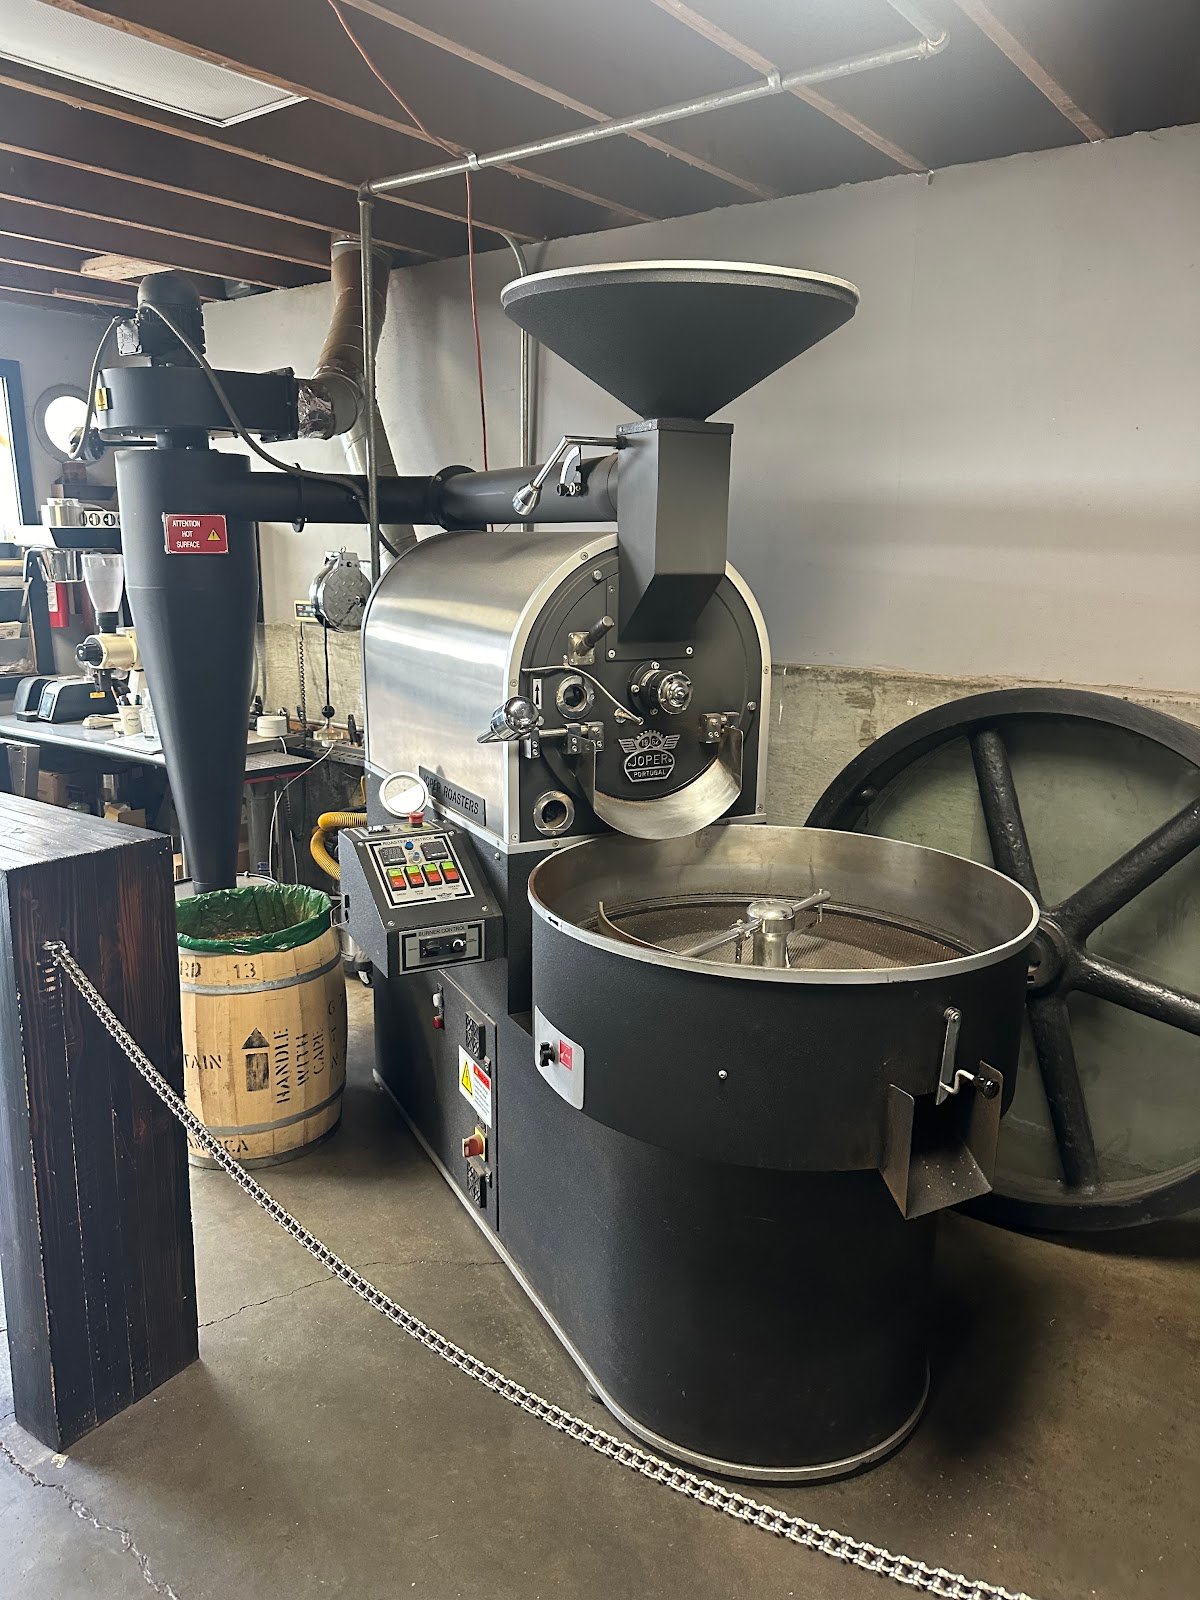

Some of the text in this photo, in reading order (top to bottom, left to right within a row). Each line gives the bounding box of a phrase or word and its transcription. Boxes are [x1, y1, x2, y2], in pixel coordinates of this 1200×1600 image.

[631, 754, 668, 767] JOPER
[633, 769, 666, 777] PORTUGAL
[443, 785, 479, 815] ROASTERS
[441, 925, 465, 934] CONTROL
[233, 961, 257, 979] 13
[295, 1033, 310, 1087] WITH
[312, 1026, 325, 1075] CARE
[274, 1028, 291, 1104] HANDLE
